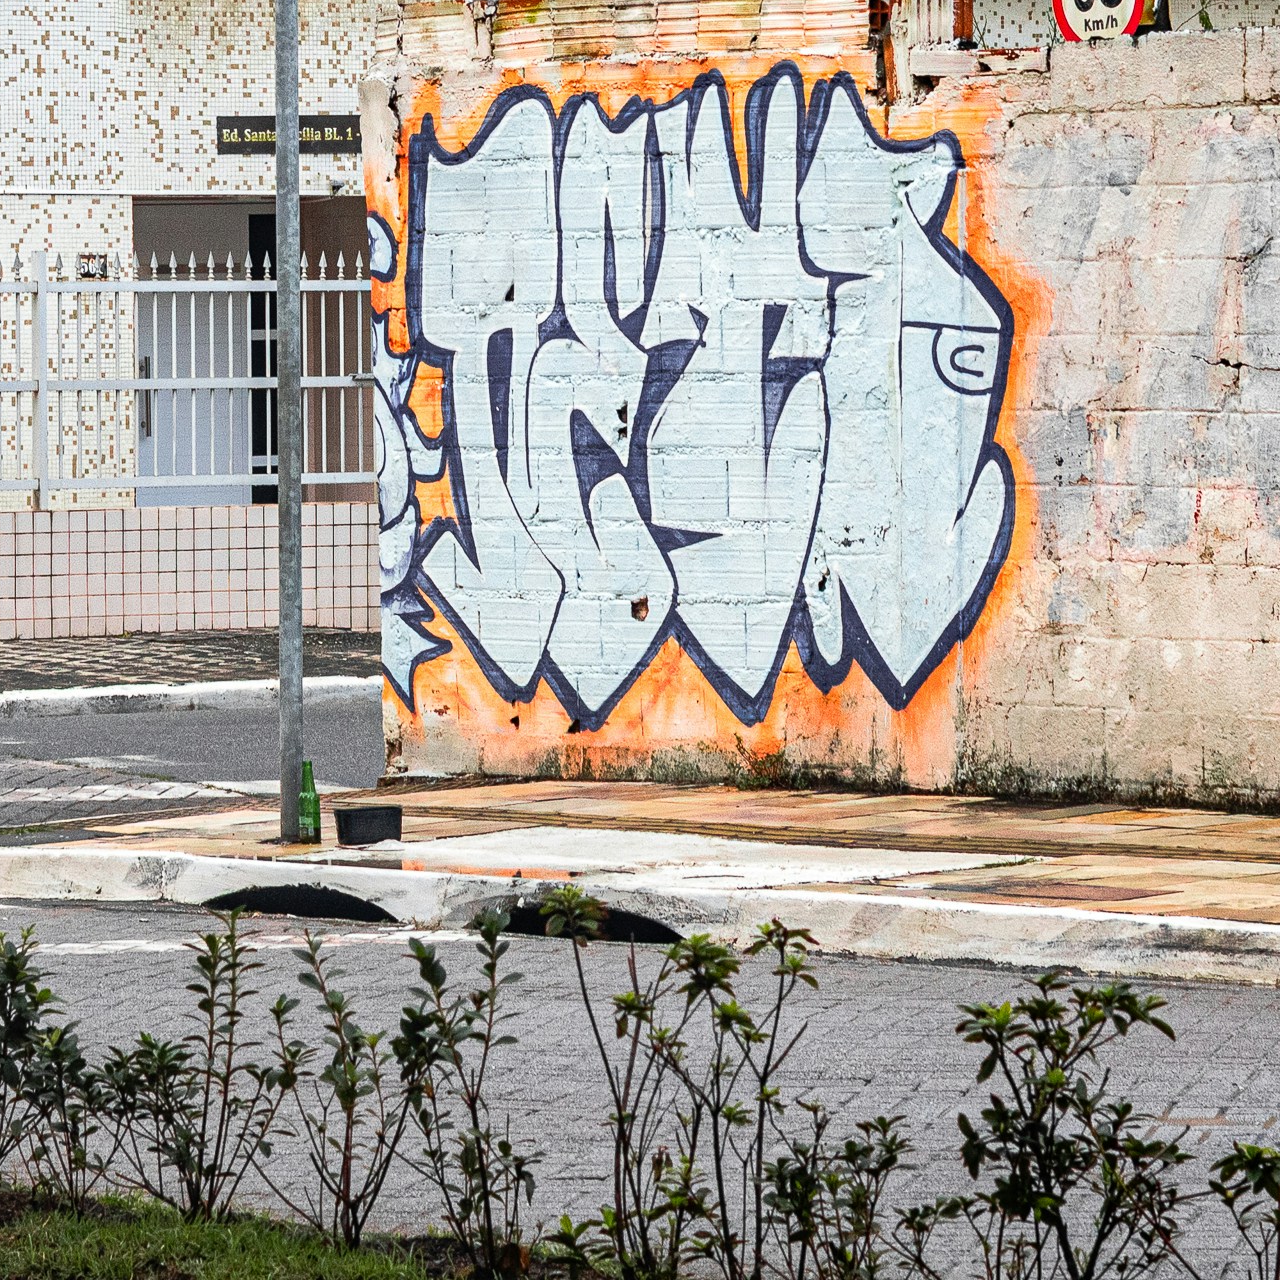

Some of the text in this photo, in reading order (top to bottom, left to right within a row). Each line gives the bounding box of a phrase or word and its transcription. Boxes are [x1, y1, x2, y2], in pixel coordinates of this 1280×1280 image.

[222, 128, 242, 142] Ed.
[244, 128, 277, 142] Santa
[298, 126, 322, 141] cília
[324, 127, 343, 141] BL.
[345, 127, 353, 141] 1
